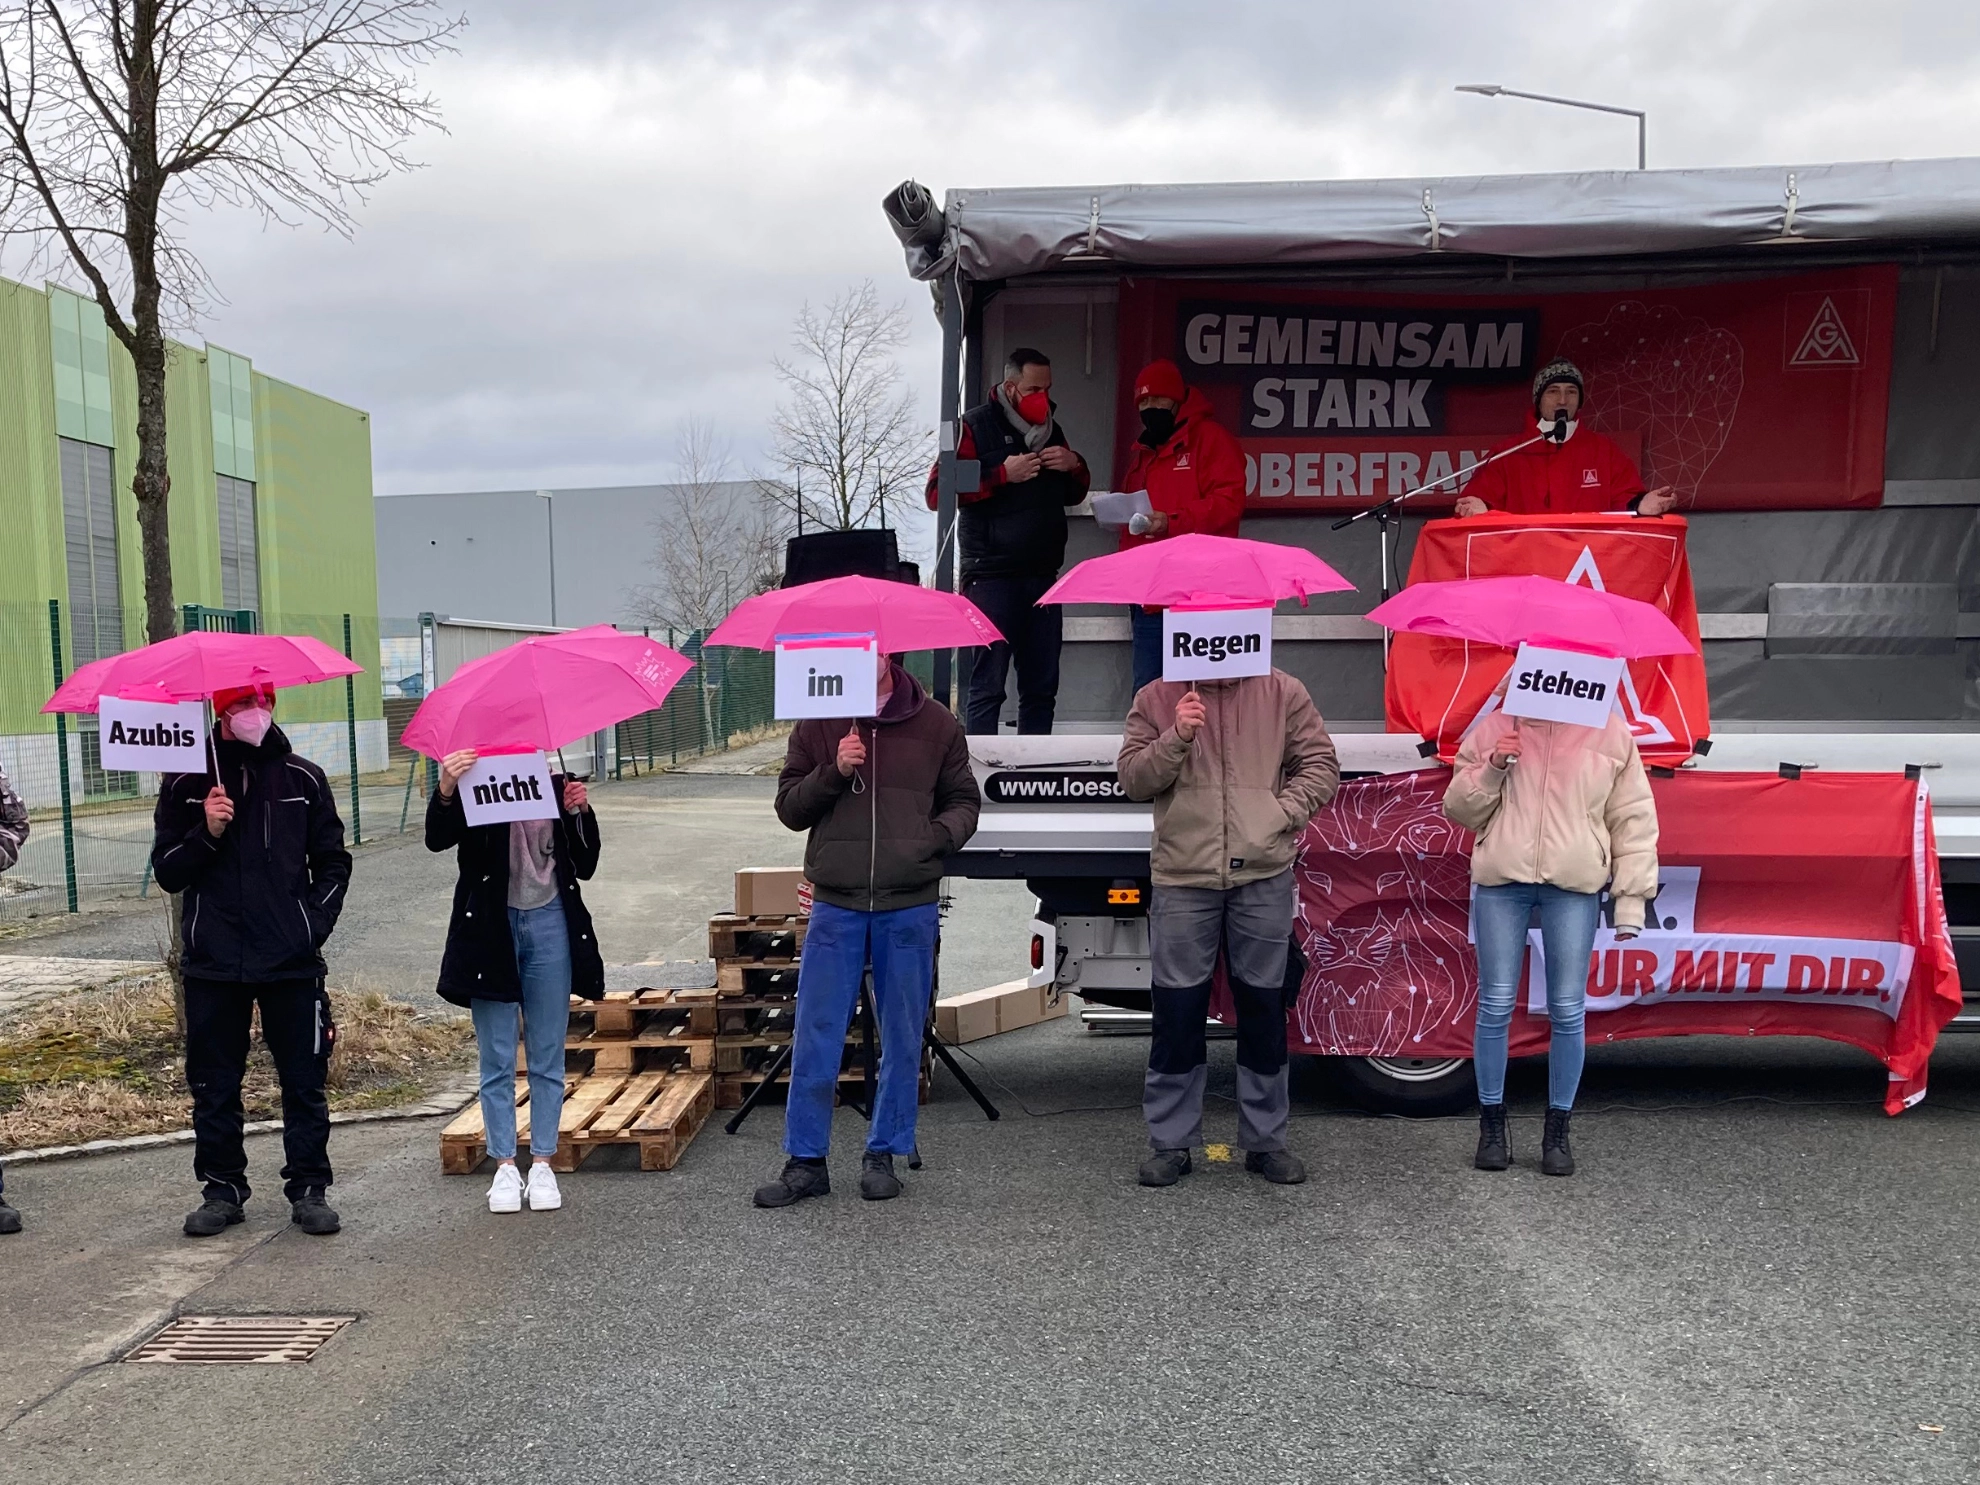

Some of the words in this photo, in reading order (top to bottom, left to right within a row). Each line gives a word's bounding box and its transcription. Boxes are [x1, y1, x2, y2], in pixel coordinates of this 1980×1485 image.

[1185, 313, 1523, 368] GEMEINSAM
[1251, 377, 1432, 428] STARK
[1173, 632, 1260, 662] Regen
[808, 667, 843, 697] im
[1517, 669, 1606, 701] stehen
[109, 720, 195, 747] Azubis
[473, 774, 543, 805] nicht
[1586, 948, 1659, 998] UR
[1668, 950, 1775, 995] MIT
[1786, 954, 1890, 1002] DIR.
